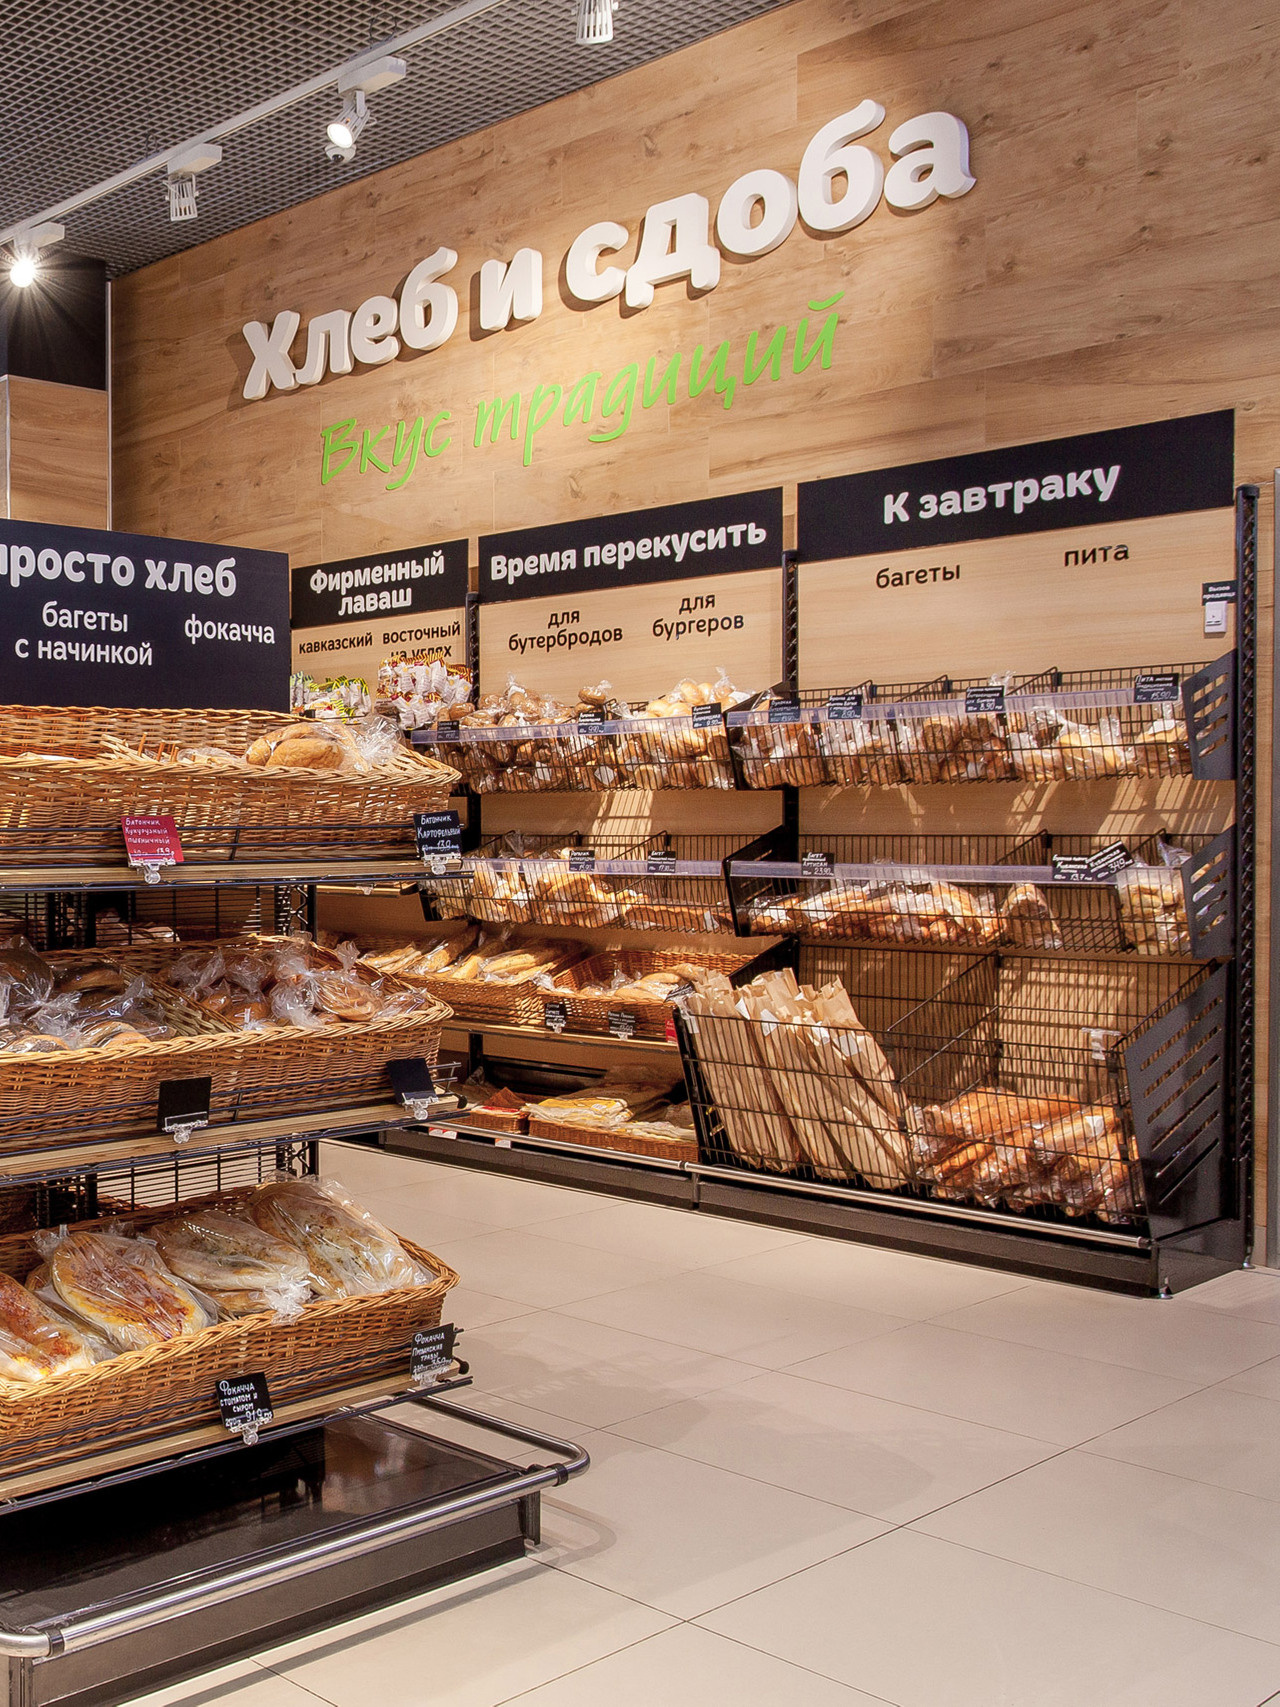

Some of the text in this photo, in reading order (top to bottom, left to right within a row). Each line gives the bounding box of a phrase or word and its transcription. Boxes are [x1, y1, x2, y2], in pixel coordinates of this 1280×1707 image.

[242, 99, 977, 399] Хлеб и сдоба
[320, 292, 845, 490] Вкус традиций
[883, 465, 1121, 525] К завтраку
[490, 522, 767, 585] Время перекусить
[1063, 544, 1130, 567] пита
[144, 557, 238, 598] хлеб
[309, 549, 445, 595] Фирменный
[875, 562, 961, 589] багеты
[337, 588, 412, 616] лаваш
[678, 594, 716, 615] для
[41, 600, 129, 633] багеты
[184, 613, 276, 645] фокачча
[547, 609, 580, 629] для
[652, 611, 745, 640] бургеров
[14, 638, 153, 666] с начинкой
[298, 620, 461, 655] кавказский восточный
[507, 625, 624, 651] бутербродов
